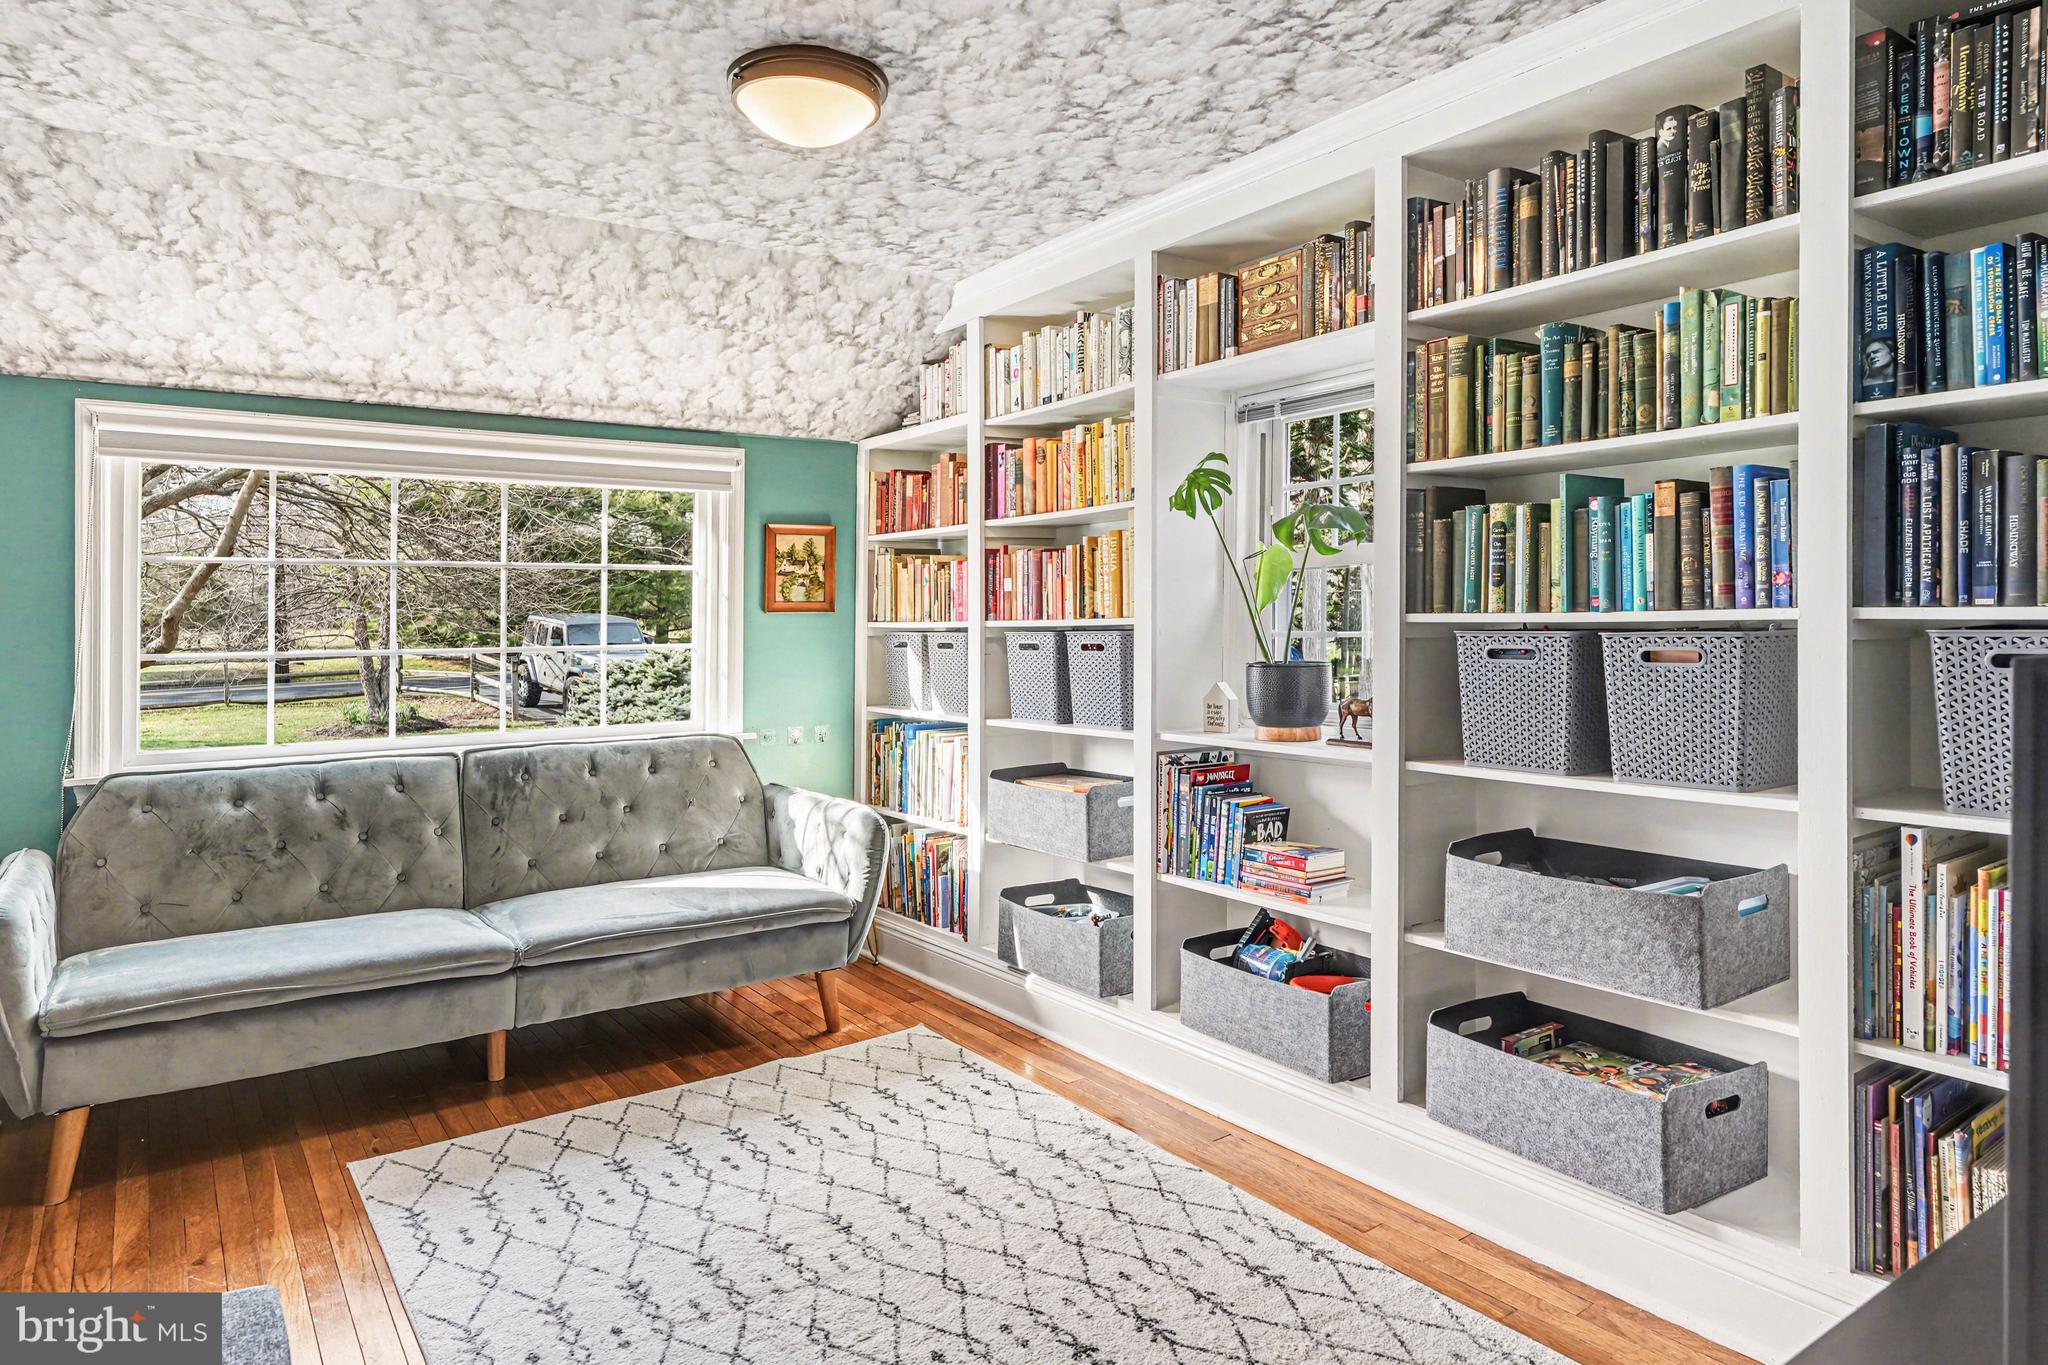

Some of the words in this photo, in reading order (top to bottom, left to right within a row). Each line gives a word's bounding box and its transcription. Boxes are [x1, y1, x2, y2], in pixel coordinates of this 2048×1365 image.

[1900, 61, 1911, 115] PAPER
[1953, 45, 1970, 112] Hemingway
[1977, 86, 1986, 108] THE
[1977, 111, 1986, 142] ROAD
[1898, 126, 1911, 180] TOWNS
[1496, 213, 1506, 269] STEPHENSON
[1876, 250, 1886, 259] A
[2021, 242, 2031, 258] HOW
[1864, 252, 1872, 281] HANYA
[2017, 260, 2026, 270] TO
[2022, 268, 2031, 279] BE
[1877, 261, 1887, 301] LITTLE
[2019, 281, 2029, 300] SAFE
[2040, 264, 2048, 309] MURAKAMI
[1877, 303, 1888, 331] LIFE
[1897, 313, 1906, 365] HEMINGWAY
[1738, 472, 1746, 488] THE
[1738, 490, 1746, 507] END
[1922, 495, 1932, 519] LOST
[1589, 517, 1599, 558] Rhyming
[1959, 520, 1969, 554] SHADE
[2009, 514, 2018, 568] HEMINGWAY
[1921, 523, 1932, 582] APOTHECARY
[1205, 770, 1236, 783] NINJAGO
[1256, 820, 1284, 842] BAD
[1908, 884, 1917, 897] The
[1908, 897, 1917, 930] Ultimate
[1909, 931, 1917, 950] Book
[1907, 951, 1917, 959] of
[1909, 961, 1918, 989] Vehicles
